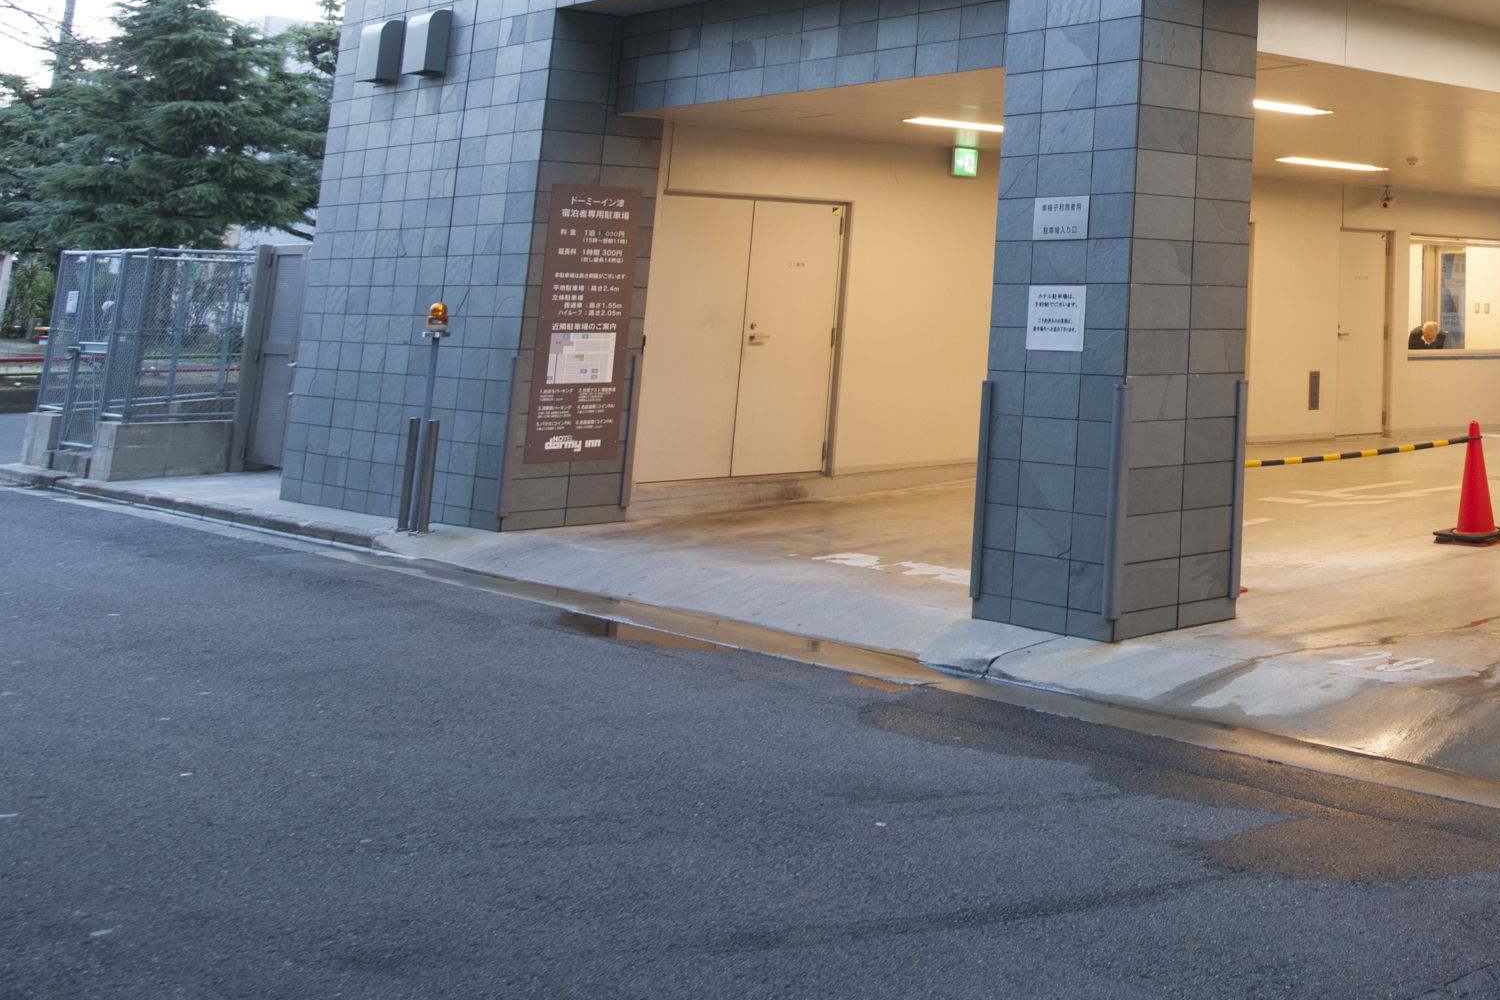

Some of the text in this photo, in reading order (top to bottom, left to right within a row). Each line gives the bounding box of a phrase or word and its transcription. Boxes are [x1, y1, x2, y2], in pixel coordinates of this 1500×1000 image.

[570, 195, 625, 208] ドーミーイン津
[561, 208, 630, 220] 宿泊者専用駐車場
[601, 249, 623, 257] 300円
[544, 438, 602, 452] dormy inn
